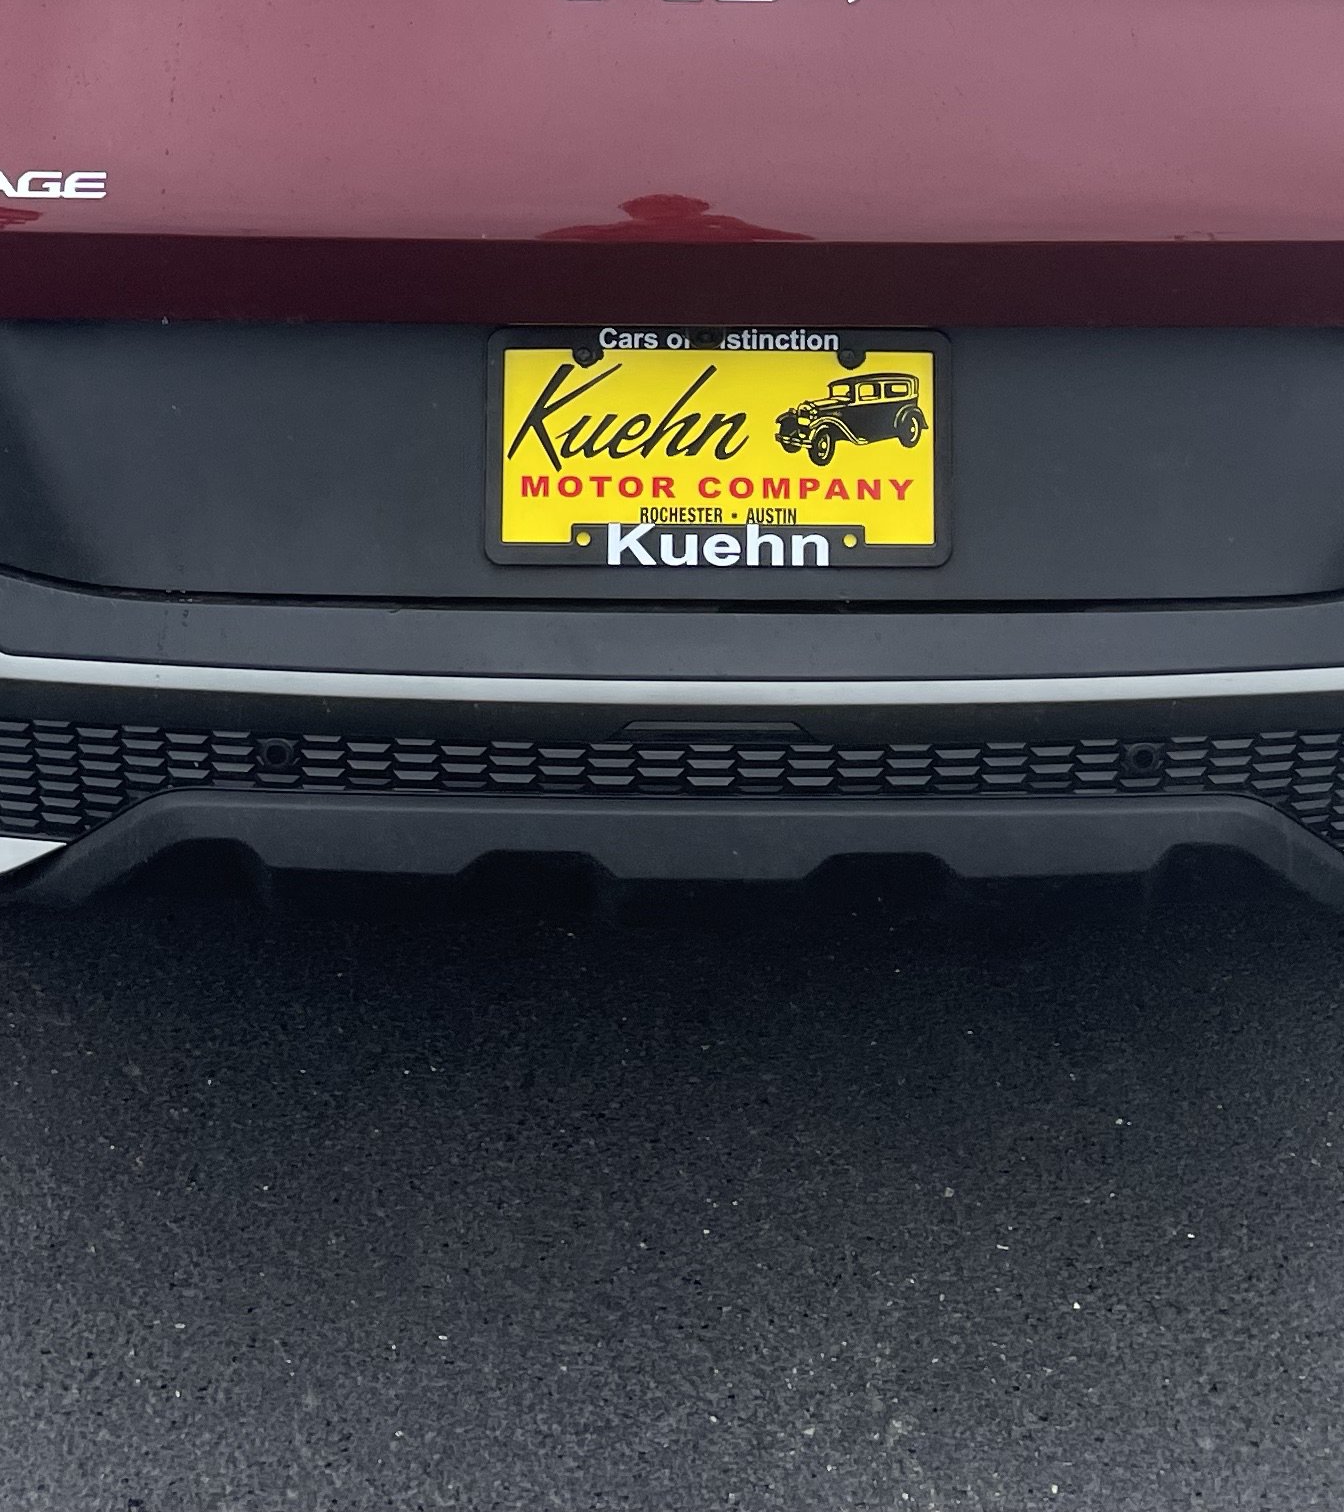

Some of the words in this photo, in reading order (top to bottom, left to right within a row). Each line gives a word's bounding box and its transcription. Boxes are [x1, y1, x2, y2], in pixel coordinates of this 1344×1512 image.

[599, 328, 658, 350] Cars
[719, 329, 839, 351] stinction
[508, 363, 749, 472] Kuehn
[520, 475, 676, 499] MOTOR
[697, 476, 915, 501] COMPANY
[639, 506, 724, 525] ROCHESTER
[746, 507, 797, 525] AUSTIN
[606, 523, 830, 568] Kuehn
